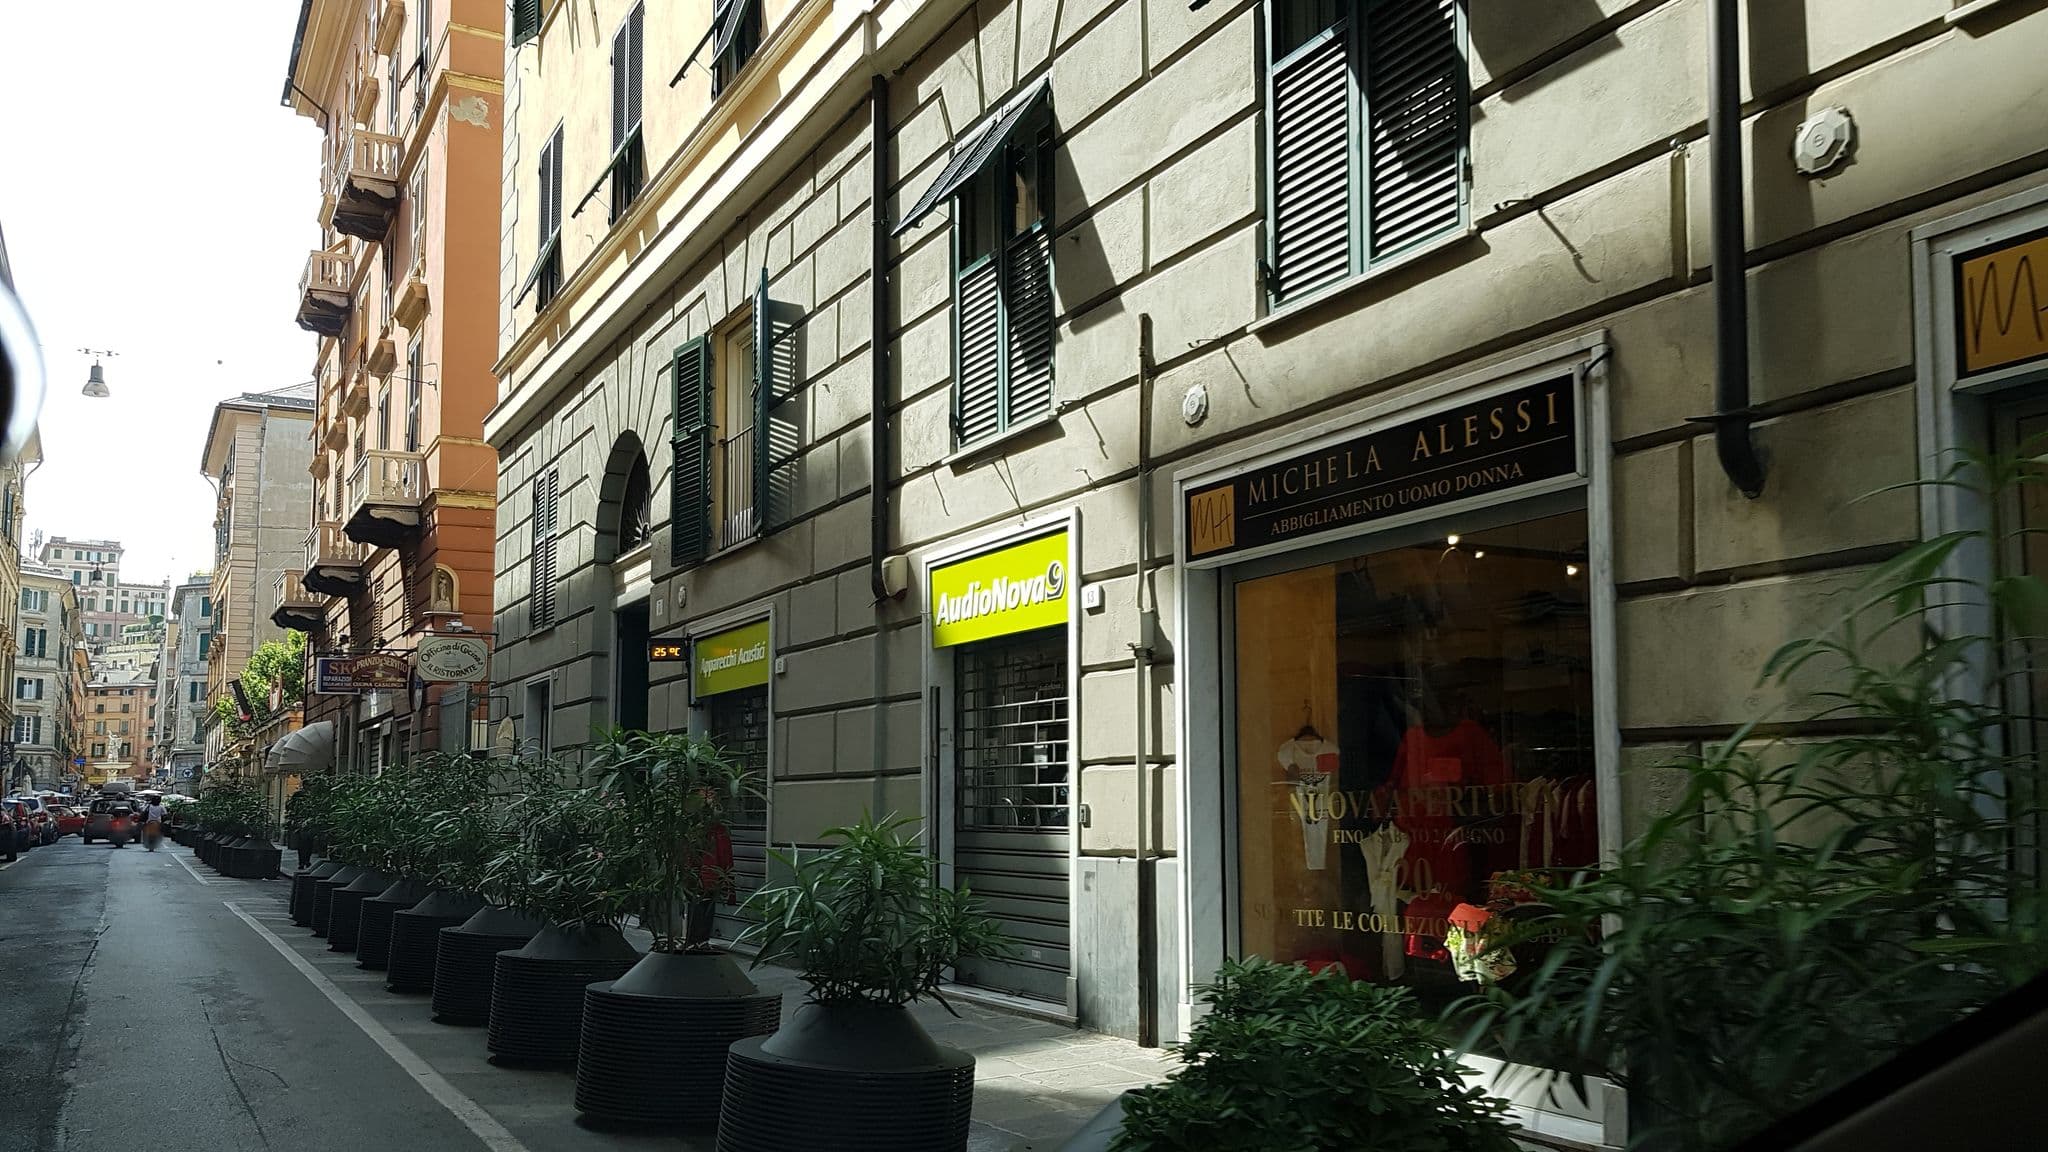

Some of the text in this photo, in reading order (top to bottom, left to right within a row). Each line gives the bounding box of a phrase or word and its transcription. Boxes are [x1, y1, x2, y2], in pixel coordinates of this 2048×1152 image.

[1968, 255, 2048, 354] M
[1249, 391, 1559, 507] MICHELA ALESSI
[1270, 461, 1525, 537] ABBIGLIAMENTO UOMO DONNA
[935, 574, 1046, 627] AudioNova
[356, 656, 380, 671] PRANZO
[420, 641, 483, 666] Officina di Cucina
[653, 647, 667, 657] 25
[701, 640, 766, 679] Apparecchi Acustici
[426, 663, 478, 678] IL RISTORANTE
[1289, 789, 1386, 822] NUOVA
[1332, 829, 1364, 844] FINO
[1332, 910, 1354, 931] LE
